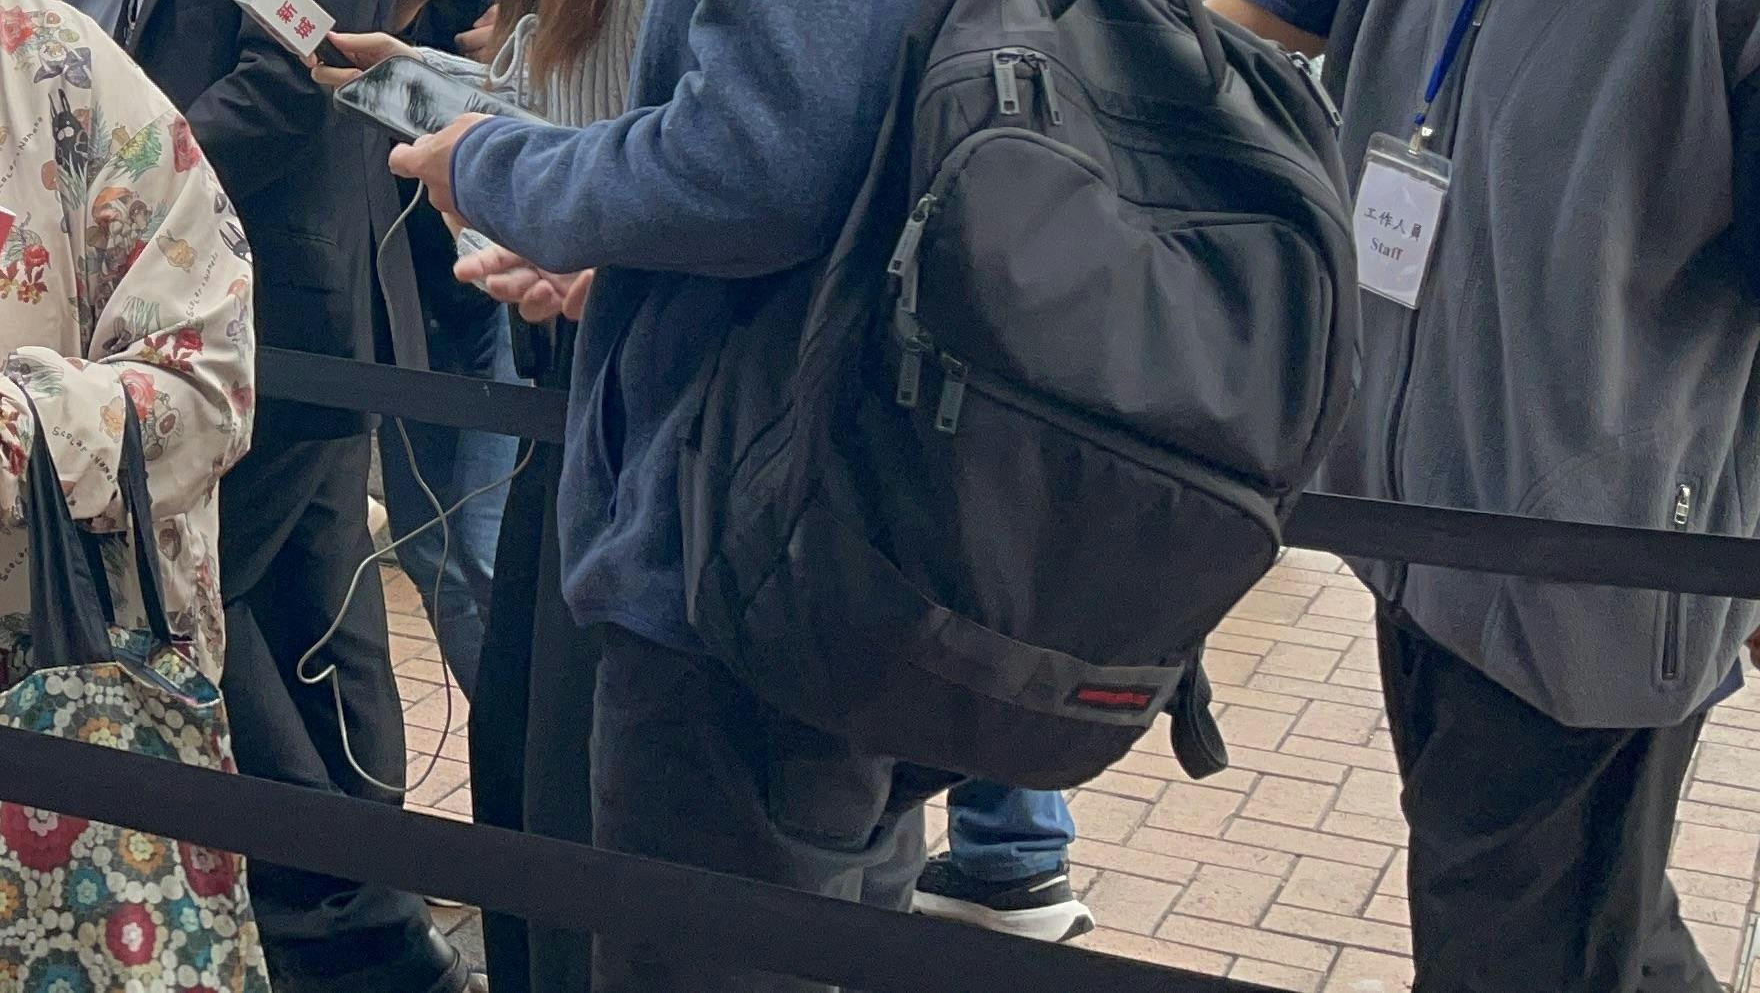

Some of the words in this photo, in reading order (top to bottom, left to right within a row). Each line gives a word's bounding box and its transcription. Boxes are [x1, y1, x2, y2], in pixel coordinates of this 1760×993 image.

[275, 0, 316, 39] 新城
[1364, 207, 1422, 242] 工作人員
[1370, 237, 1404, 261] Staff
